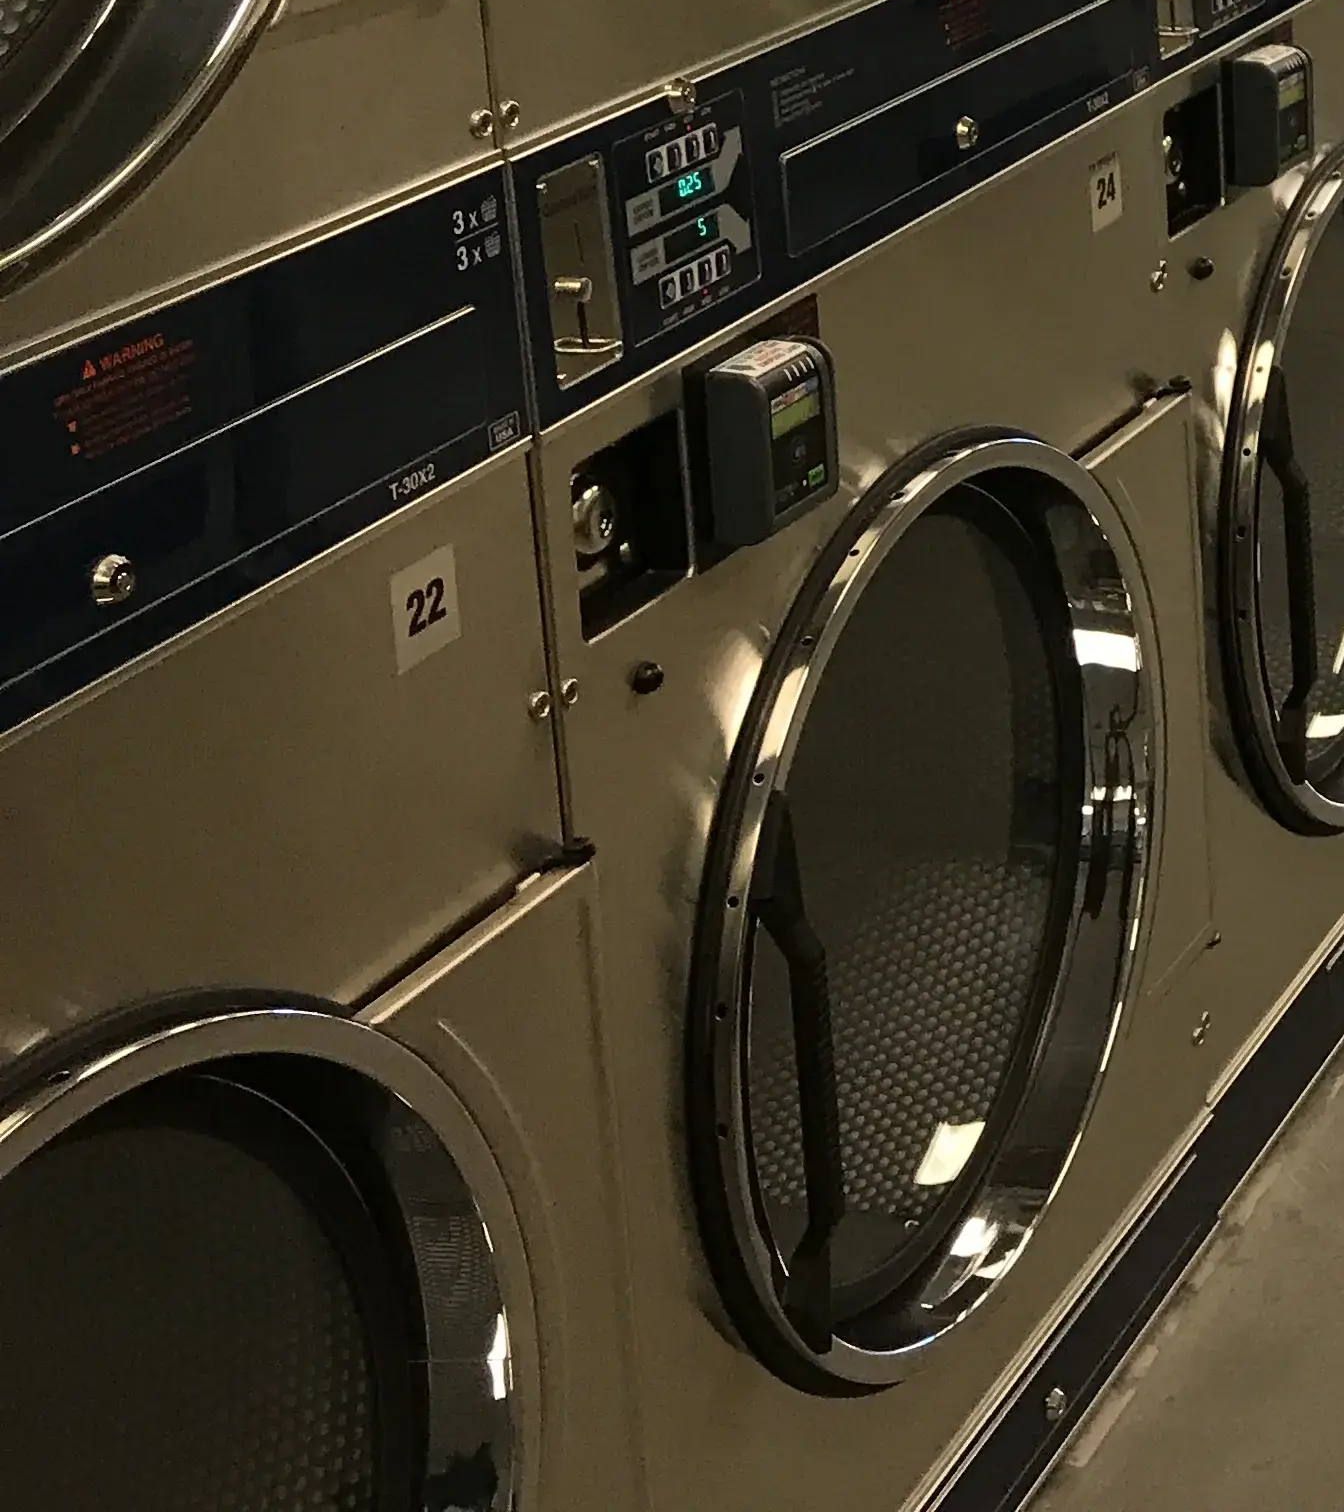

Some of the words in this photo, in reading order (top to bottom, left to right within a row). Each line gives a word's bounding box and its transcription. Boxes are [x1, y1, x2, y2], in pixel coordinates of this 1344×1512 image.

[1096, 172, 1116, 210] 24
[452, 209, 465, 235] 3
[468, 210, 478, 230] x
[697, 217, 707, 237] 5
[456, 245, 470, 272] 3
[472, 245, 483, 266] x
[99, 333, 165, 371] WARNING
[388, 462, 437, 502] T-30X2
[406, 577, 448, 638] 22
